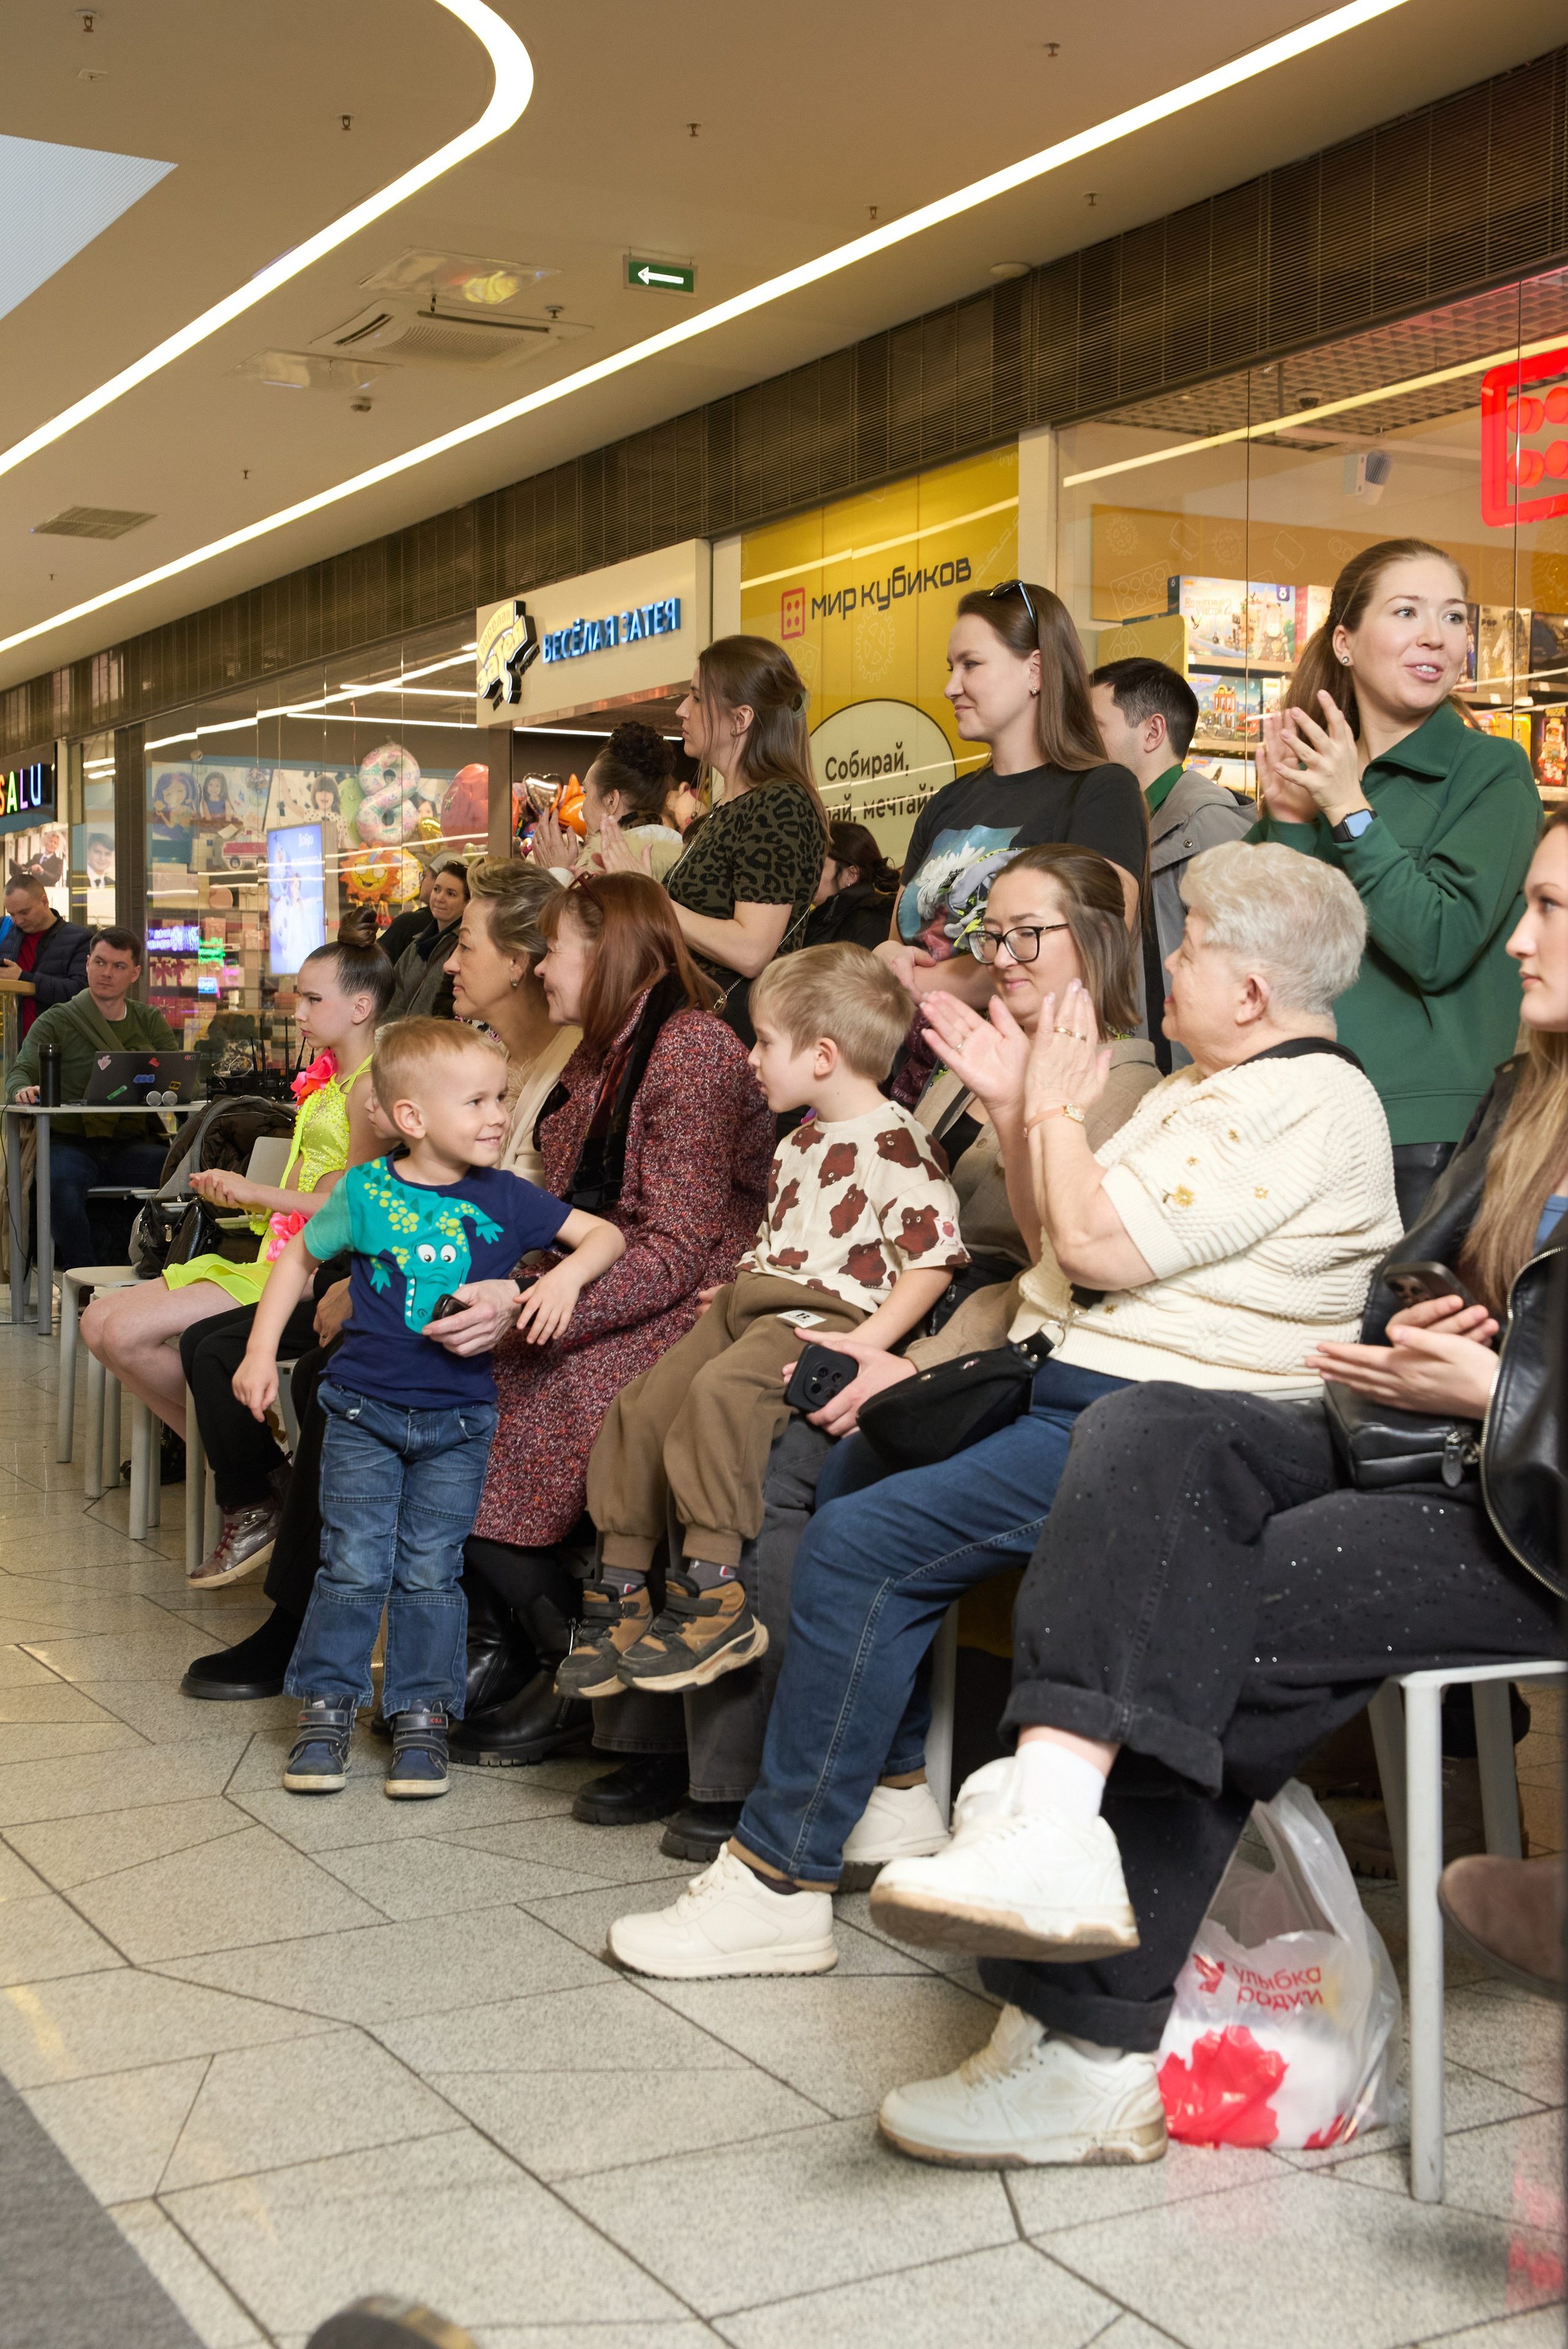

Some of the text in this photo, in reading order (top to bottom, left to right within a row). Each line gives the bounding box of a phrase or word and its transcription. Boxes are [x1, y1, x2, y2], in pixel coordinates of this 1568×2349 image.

[812, 557, 971, 620] мир кубиков
[543, 597, 679, 664] ВЕСЁЛАЯ ЗАТЕЯ
[825, 741, 910, 782] Собирай,
[298, 832, 314, 849] Добро
